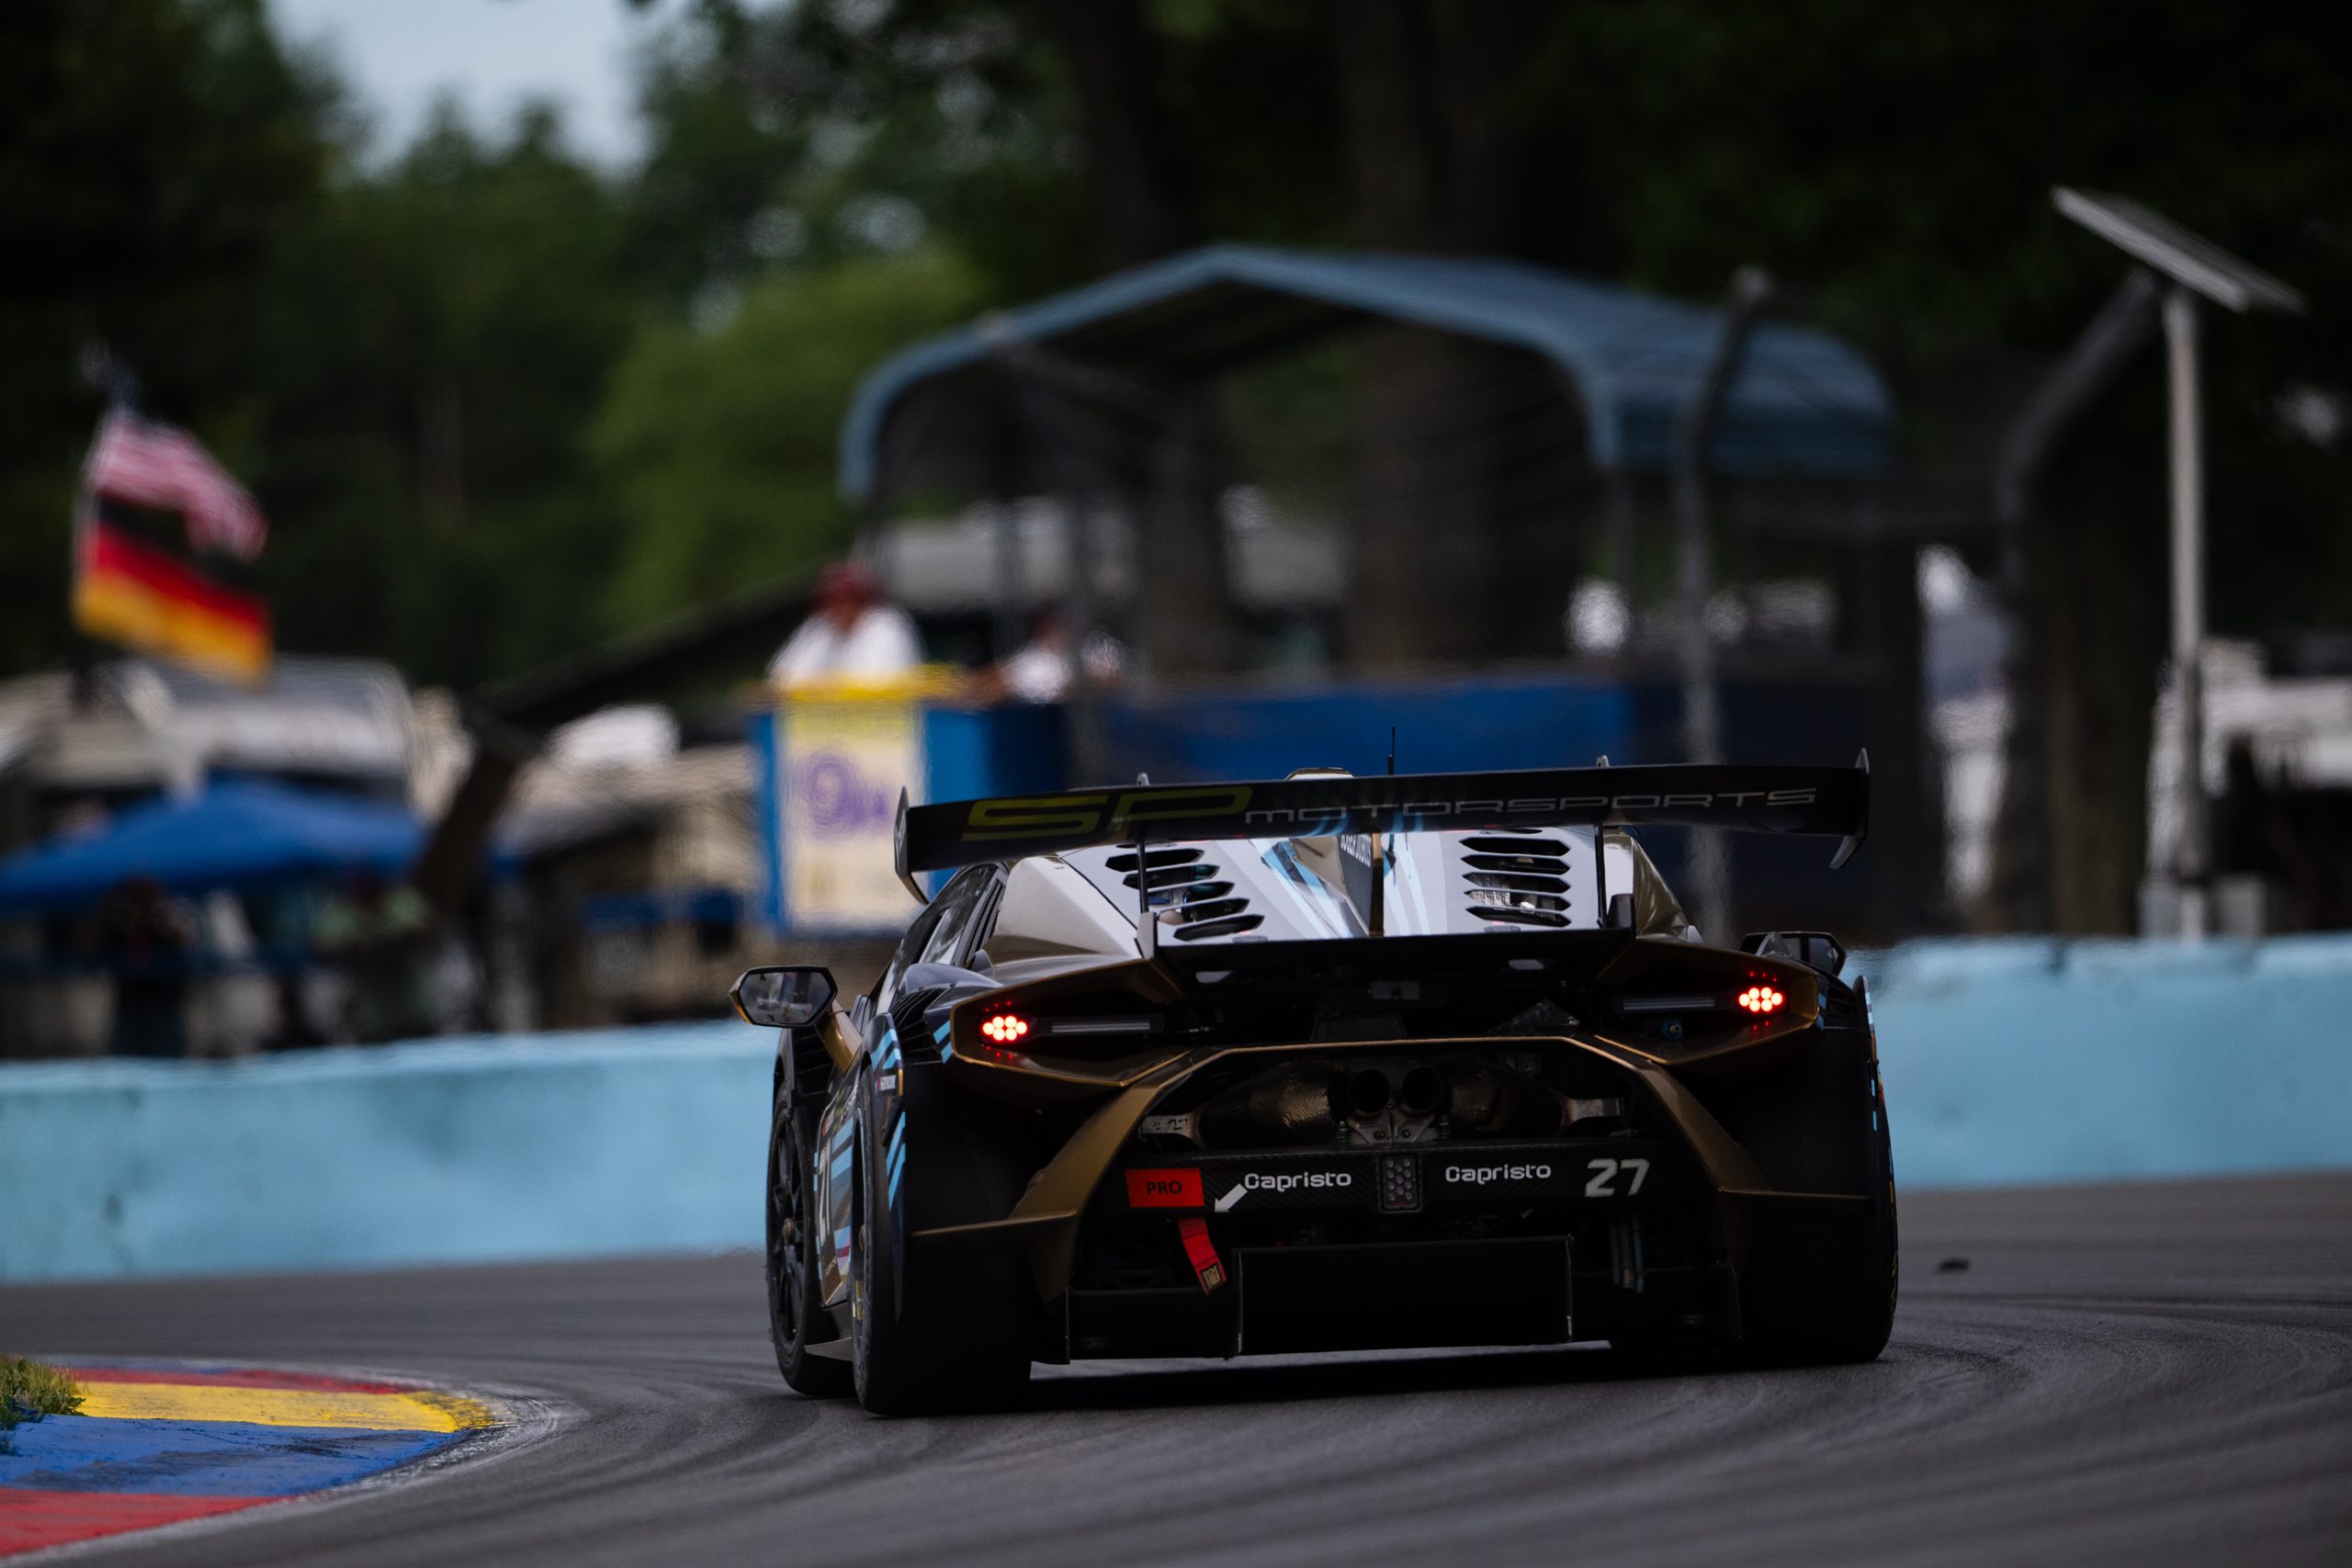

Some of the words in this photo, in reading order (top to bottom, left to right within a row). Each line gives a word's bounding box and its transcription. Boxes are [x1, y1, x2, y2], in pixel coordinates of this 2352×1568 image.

[960, 785, 1255, 842] SP
[1245, 787, 1818, 824] MOTORSPORTS
[1244, 1171, 1351, 1192] Capristo
[1445, 1163, 1552, 1185] Capristo
[1584, 1157, 1651, 1198] 27
[1147, 1180, 1182, 1194] PRO
